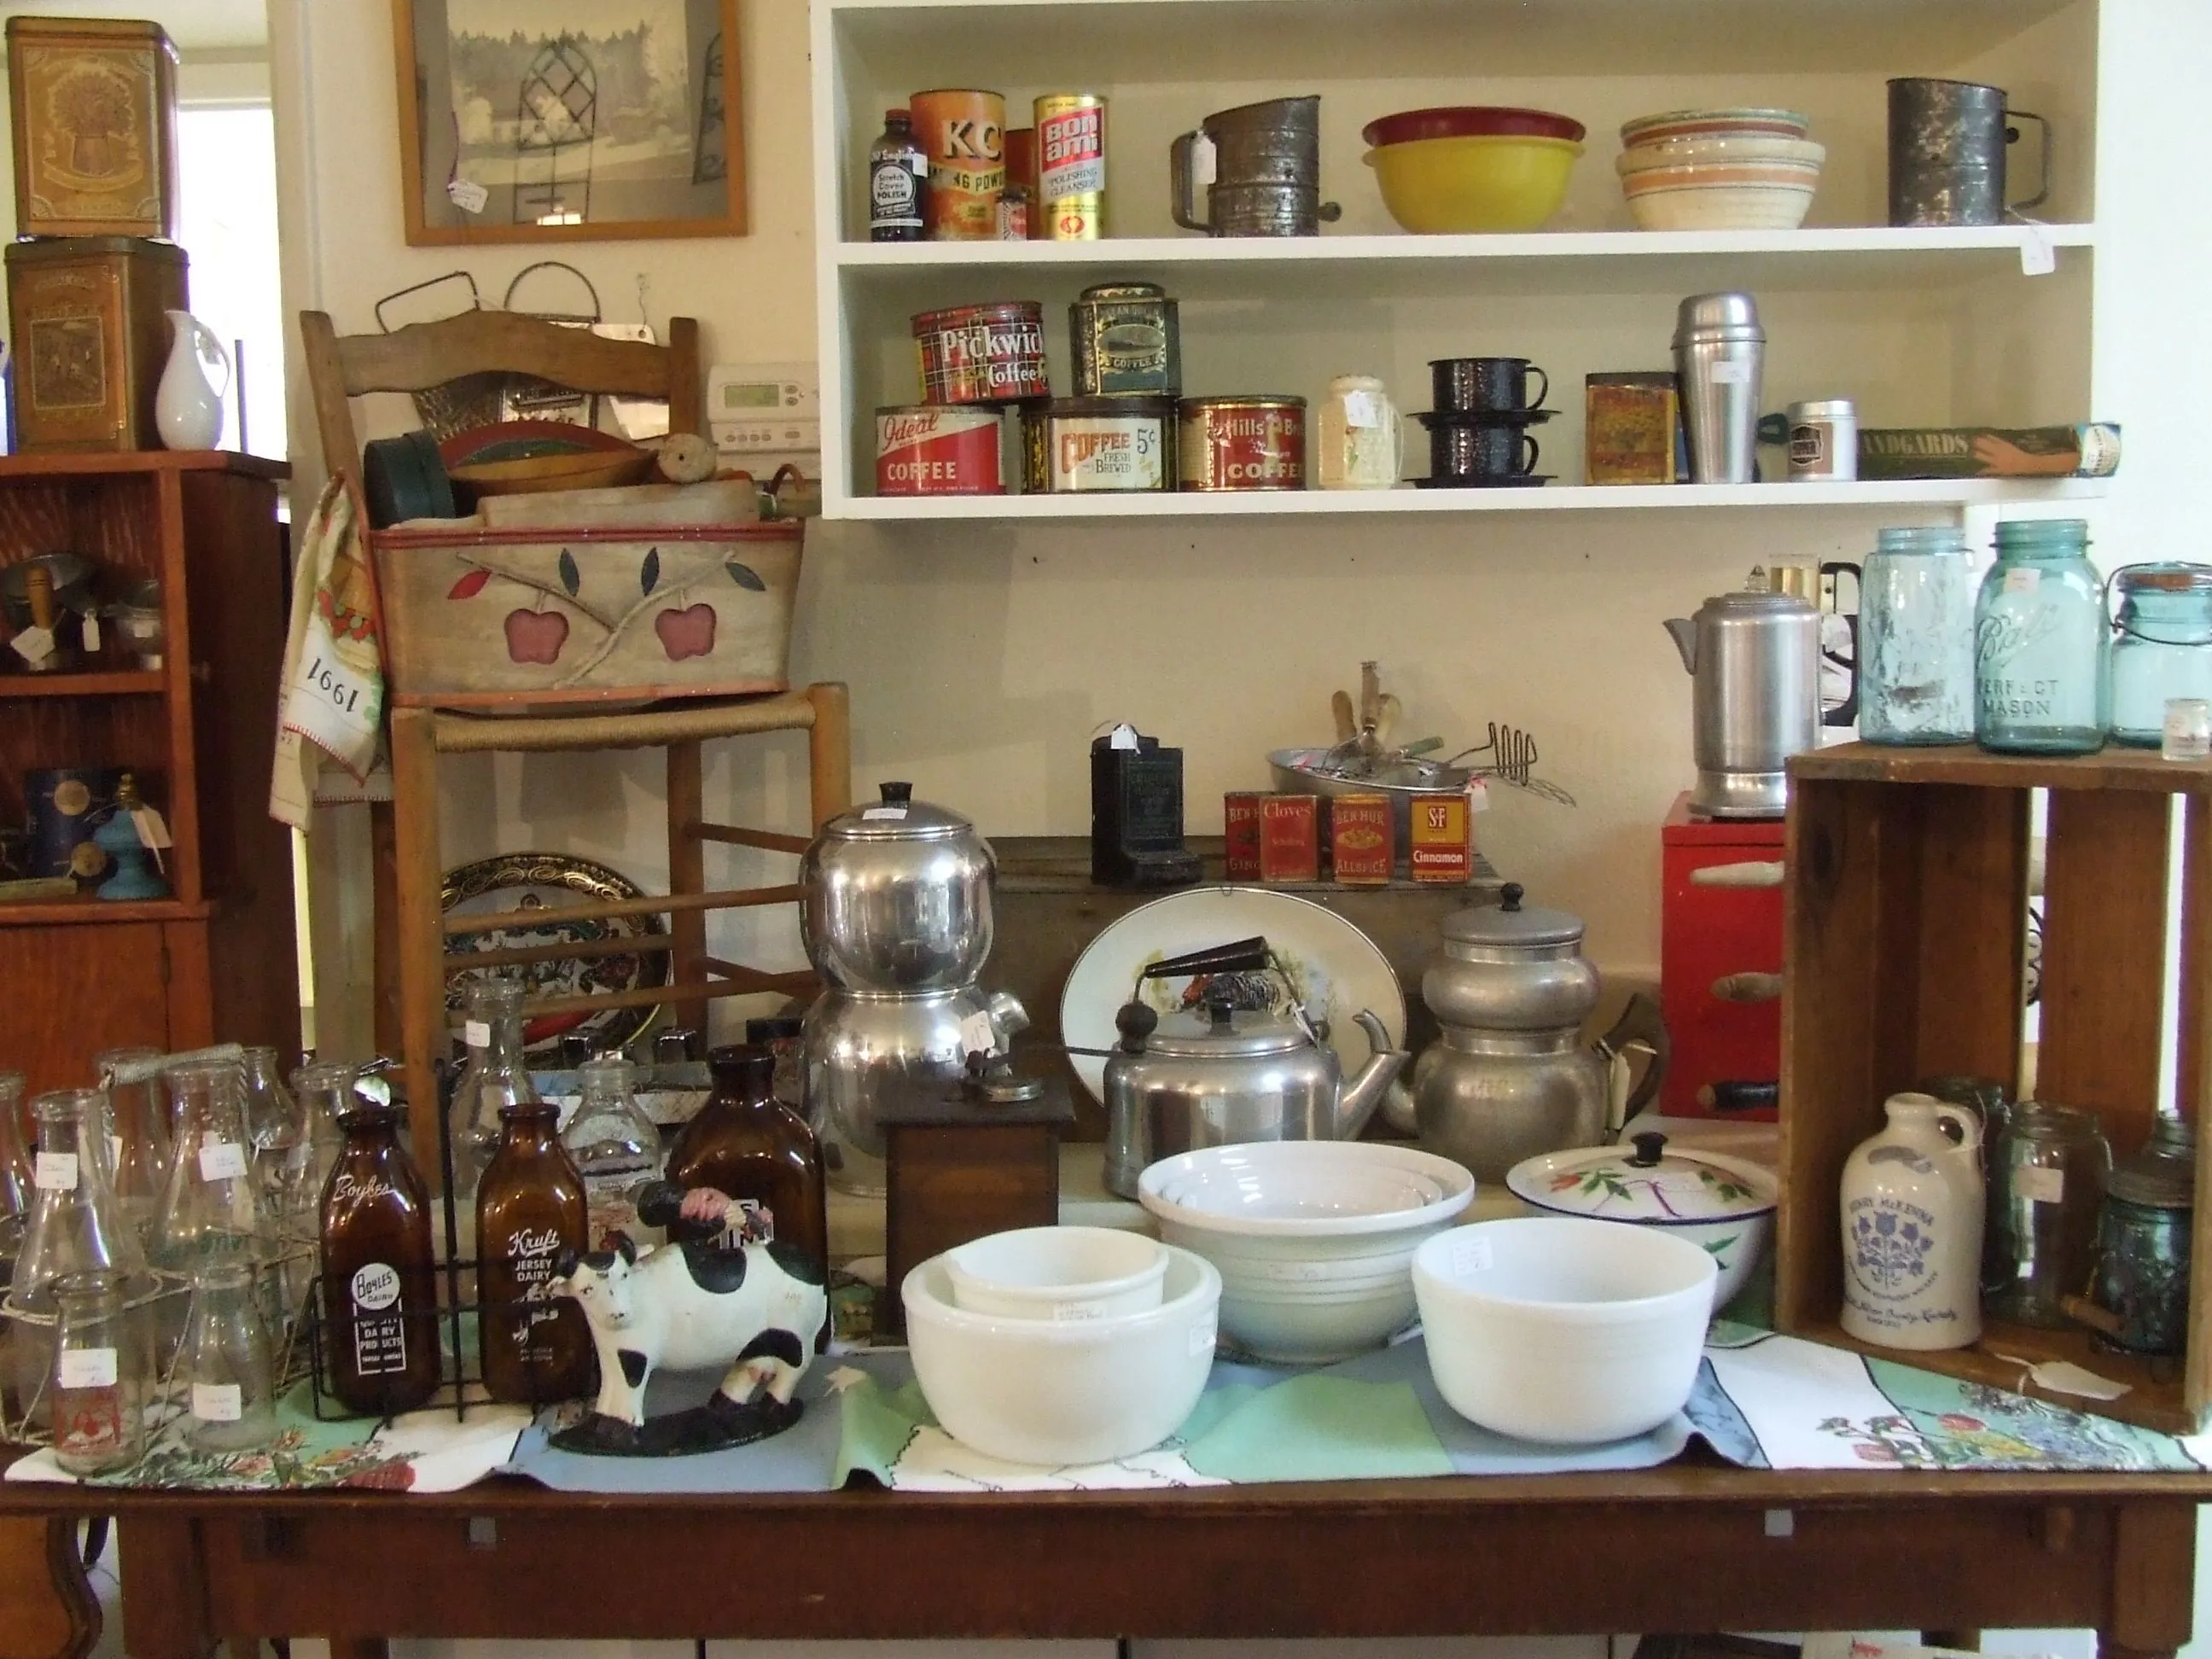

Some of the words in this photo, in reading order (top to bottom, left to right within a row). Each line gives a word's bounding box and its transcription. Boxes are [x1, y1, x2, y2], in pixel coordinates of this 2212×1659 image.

[941, 118, 1002, 160] KC
[877, 190, 907, 200] POLISH
[988, 362, 1036, 388] Coffee
[882, 412, 940, 451] Ideal
[1062, 433, 1131, 474] COFFEE
[1104, 452, 1131, 463] FRESH
[888, 462, 956, 480] COFFEE
[1982, 699, 2051, 716] MASON
[1264, 802, 1312, 819] Cloves
[1413, 850, 1463, 864] Cinnamon
[515, 1259, 552, 1271] JERSEY
[517, 1271, 550, 1282] DAIRY
[364, 1326, 395, 1339] DARY
[360, 1336, 403, 1350] PROUCTS
